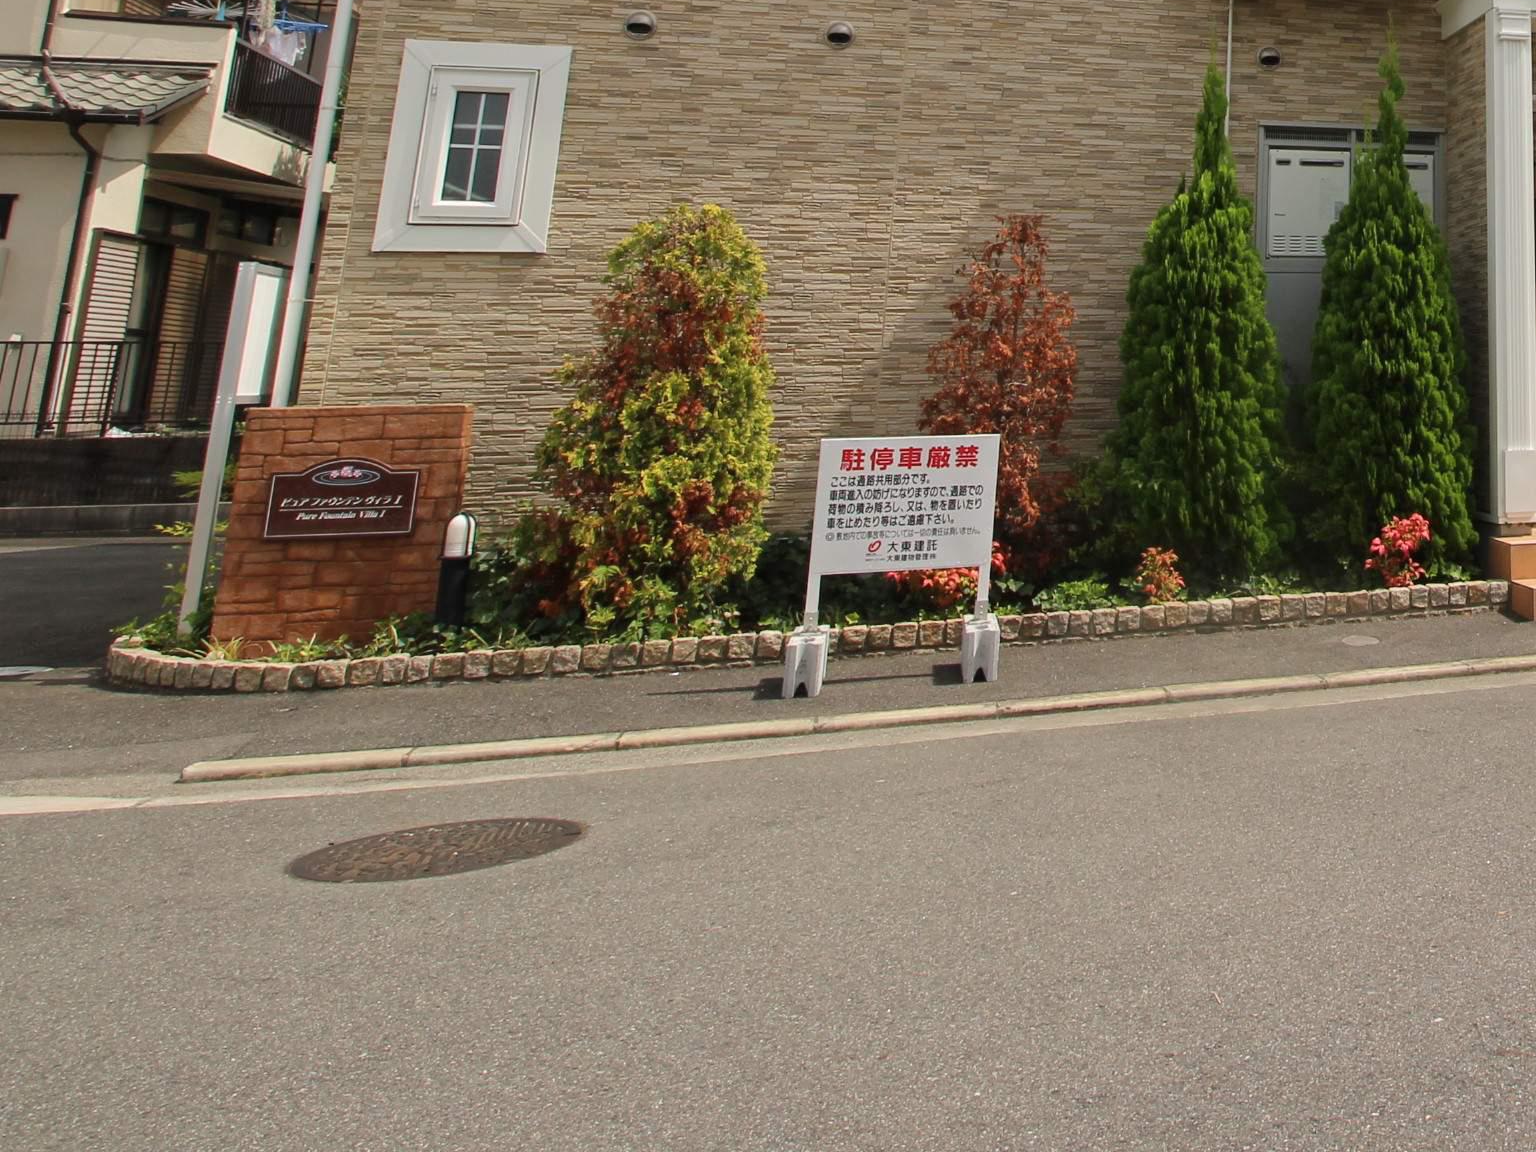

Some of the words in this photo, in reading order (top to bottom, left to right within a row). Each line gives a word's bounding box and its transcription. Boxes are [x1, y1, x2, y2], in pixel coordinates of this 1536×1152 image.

[840, 445, 979, 471] 駐停車厳禁
[281, 498, 309, 507] ピュア
[296, 512, 318, 521] Pure
[319, 511, 356, 520] Fountain
[888, 539, 938, 553] 大東建託
